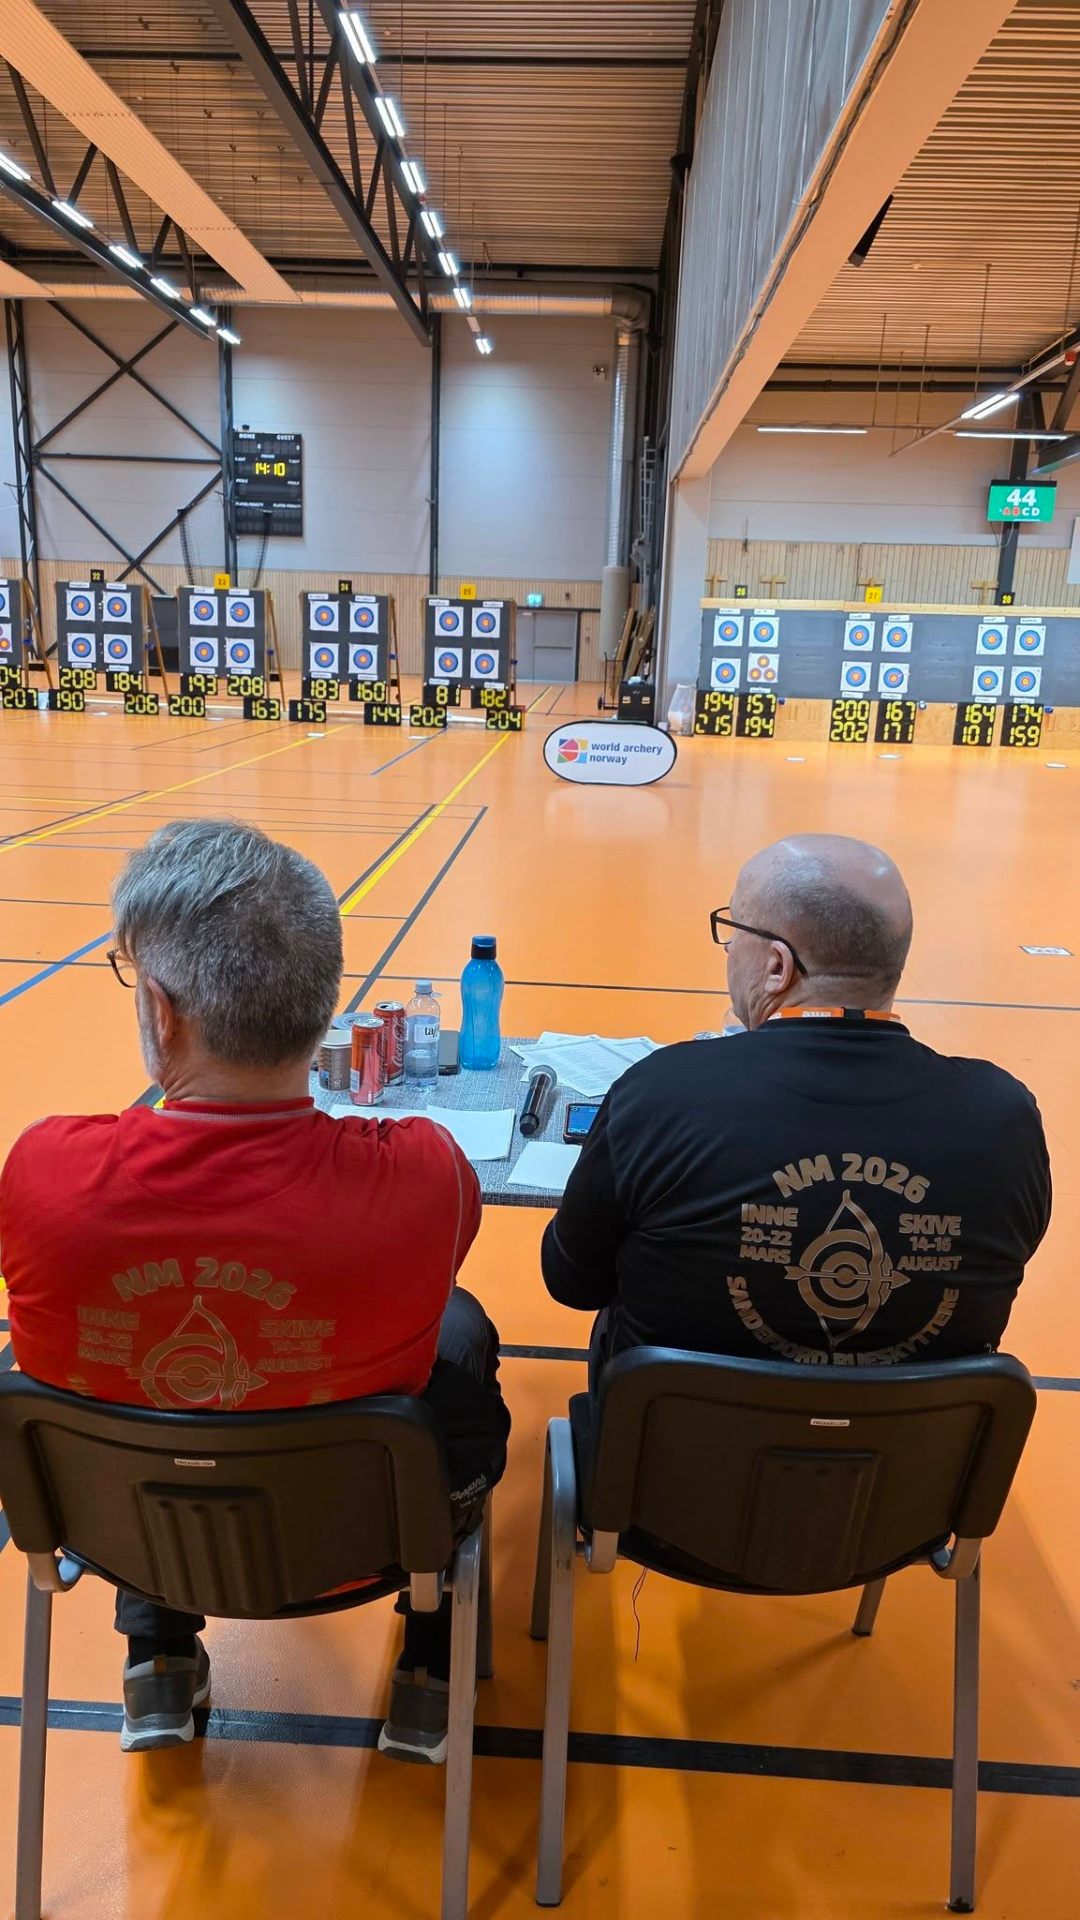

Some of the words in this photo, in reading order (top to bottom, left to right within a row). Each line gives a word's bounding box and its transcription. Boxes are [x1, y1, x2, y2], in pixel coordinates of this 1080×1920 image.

[255, 462, 286, 476] 14:10
[1006, 488, 1037, 507] 44
[60, 668, 97, 689] 208
[113, 672, 143, 692] 184
[188, 674, 217, 695] 193
[227, 675, 264, 697] 208
[3, 688, 38, 708] 207
[310, 679, 339, 700] 183
[357, 681, 386, 702] 160
[480, 688, 507, 708] 182
[56, 690, 84, 711] 190
[125, 694, 158, 714] 206
[169, 695, 205, 717] 200
[251, 699, 280, 720] 163
[704, 691, 734, 712] 194
[746, 693, 776, 715] 157
[832, 699, 870, 721] 200
[297, 701, 325, 722] 175
[372, 706, 400, 724] 144
[410, 705, 446, 727] 202
[486, 710, 521, 730] 204
[885, 701, 916, 722] 167
[965, 703, 995, 724] 164
[1012, 704, 1043, 724] 174
[744, 716, 774, 737] 194
[830, 720, 868, 742] 202
[883, 721, 914, 741] 171
[962, 724, 993, 746] 101
[1010, 725, 1040, 747] 159
[591, 742, 621, 753] world
[623, 743, 663, 756] archery
[589, 754, 628, 766] norway
[772, 1154, 835, 1198] NM
[842, 1153, 930, 1204] 2026
[741, 1203, 799, 1227] INNE
[898, 1213, 962, 1236] SKIVE
[741, 1226, 793, 1247] 20-22
[909, 1236, 952, 1252] 14-16
[740, 1244, 792, 1265] MARS
[897, 1256, 962, 1271] AUGUST
[111, 1258, 185, 1303] NM
[193, 1256, 298, 1311] 2026
[77, 1304, 141, 1332] INNE
[258, 1318, 338, 1338] SKIVE
[78, 1326, 134, 1350] 20-22
[253, 1355, 335, 1374] AUGUST
